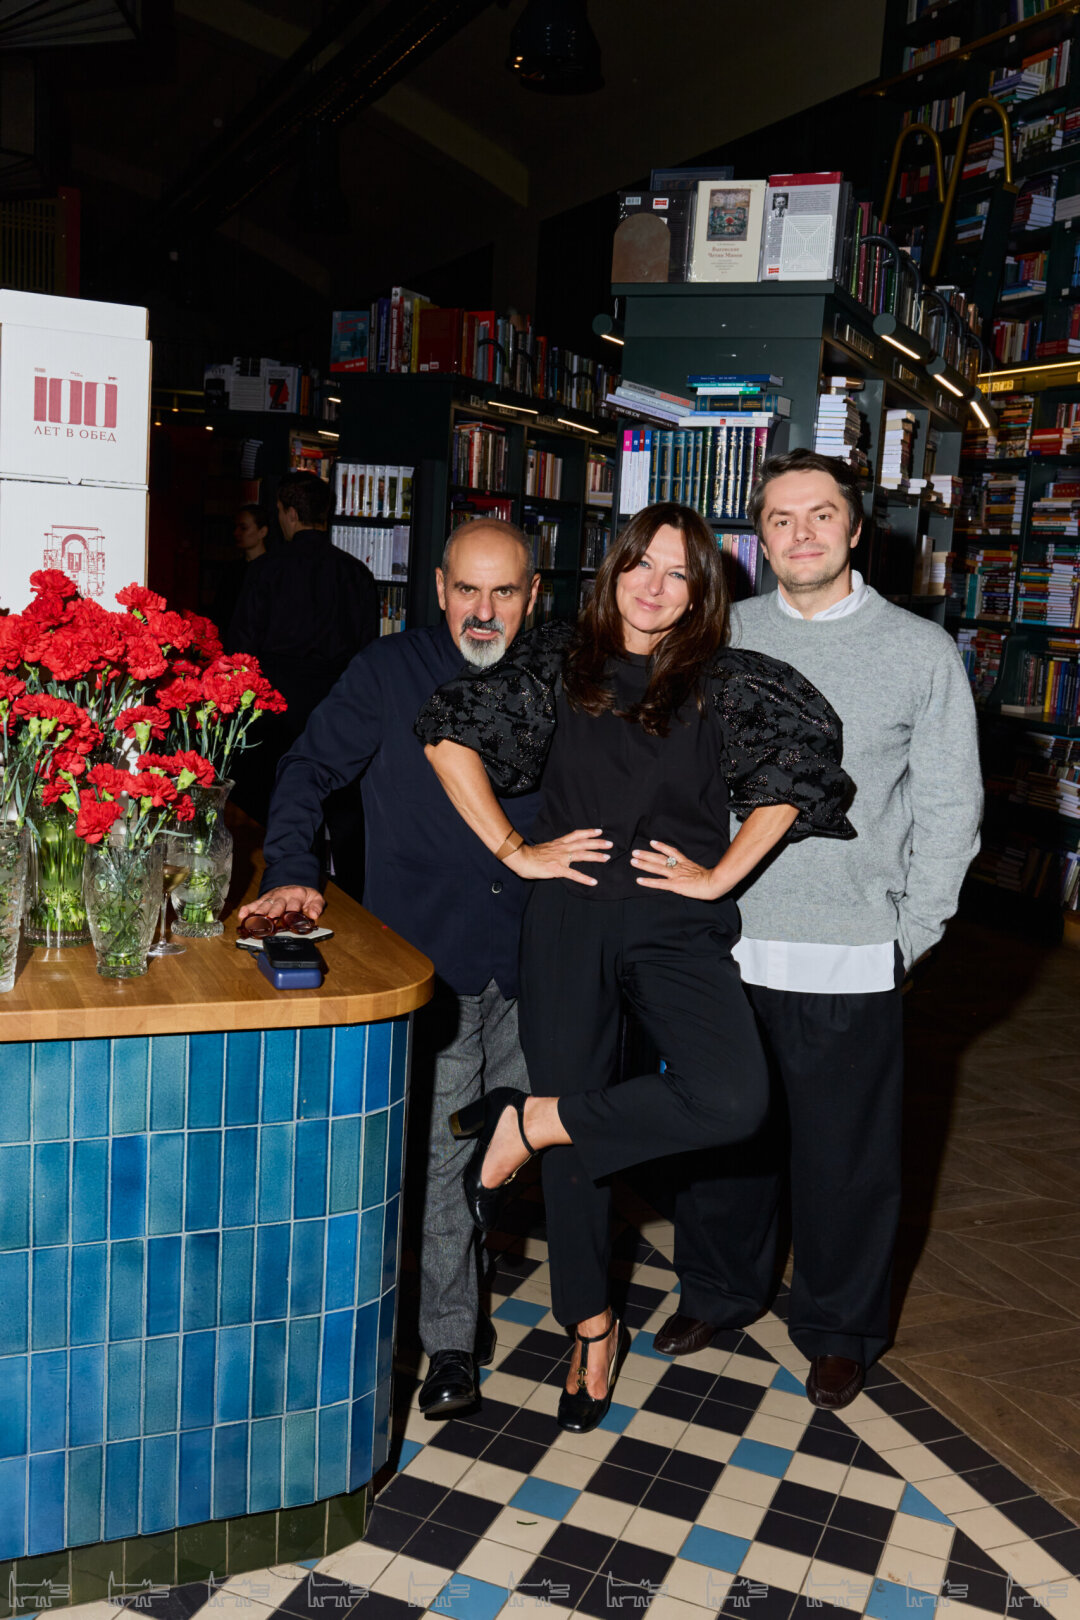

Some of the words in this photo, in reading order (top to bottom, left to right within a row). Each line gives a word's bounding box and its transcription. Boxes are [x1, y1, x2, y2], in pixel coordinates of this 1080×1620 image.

[34, 376, 117, 428] 100
[34, 425, 60, 437] ЛЕТ
[66, 427, 74, 438] В
[79, 429, 117, 443] ОБЕД
